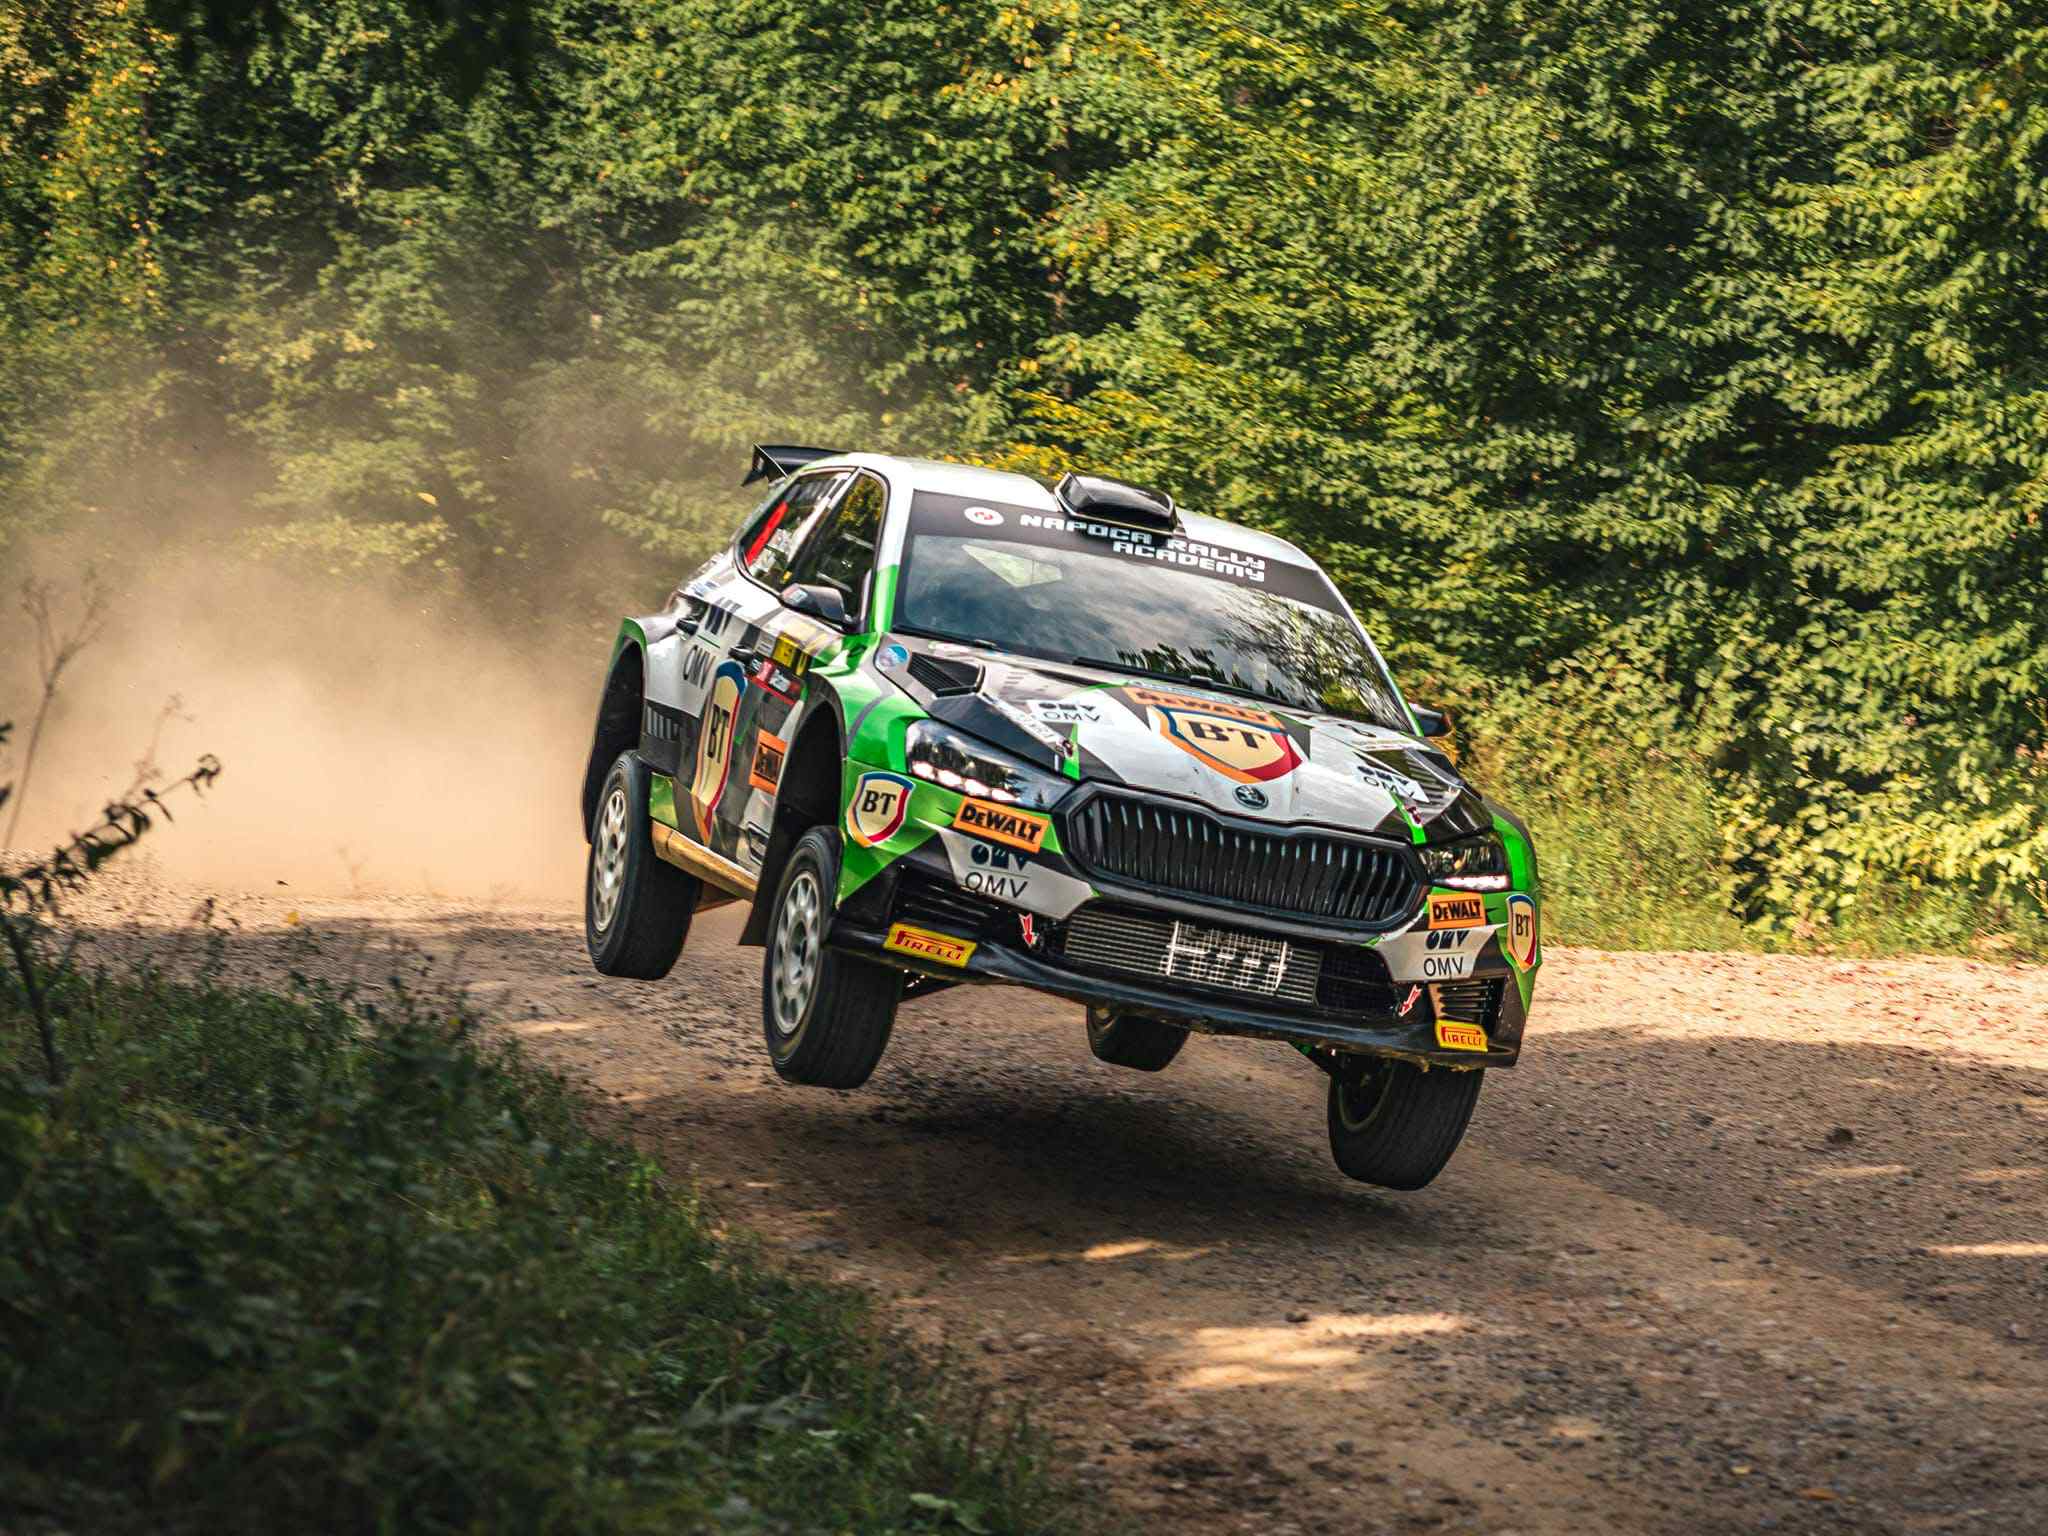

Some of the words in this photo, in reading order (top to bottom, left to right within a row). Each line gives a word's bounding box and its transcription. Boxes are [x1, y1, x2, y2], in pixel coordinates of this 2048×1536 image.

[1020, 514, 1153, 545] NAPOCA
[1167, 537, 1266, 569] RALLY
[1113, 540, 1265, 582] ACADEMY
[1042, 711, 1102, 723] OMV
[706, 703, 730, 764] BT
[1186, 721, 1266, 749] BT
[862, 790, 897, 815] BT
[964, 871, 1029, 899] OMV
[1515, 912, 1531, 938] BT
[895, 929, 965, 961] PIRELLI
[1423, 956, 1464, 977] OMV
[1440, 1026, 1482, 1047] PIRELLI
